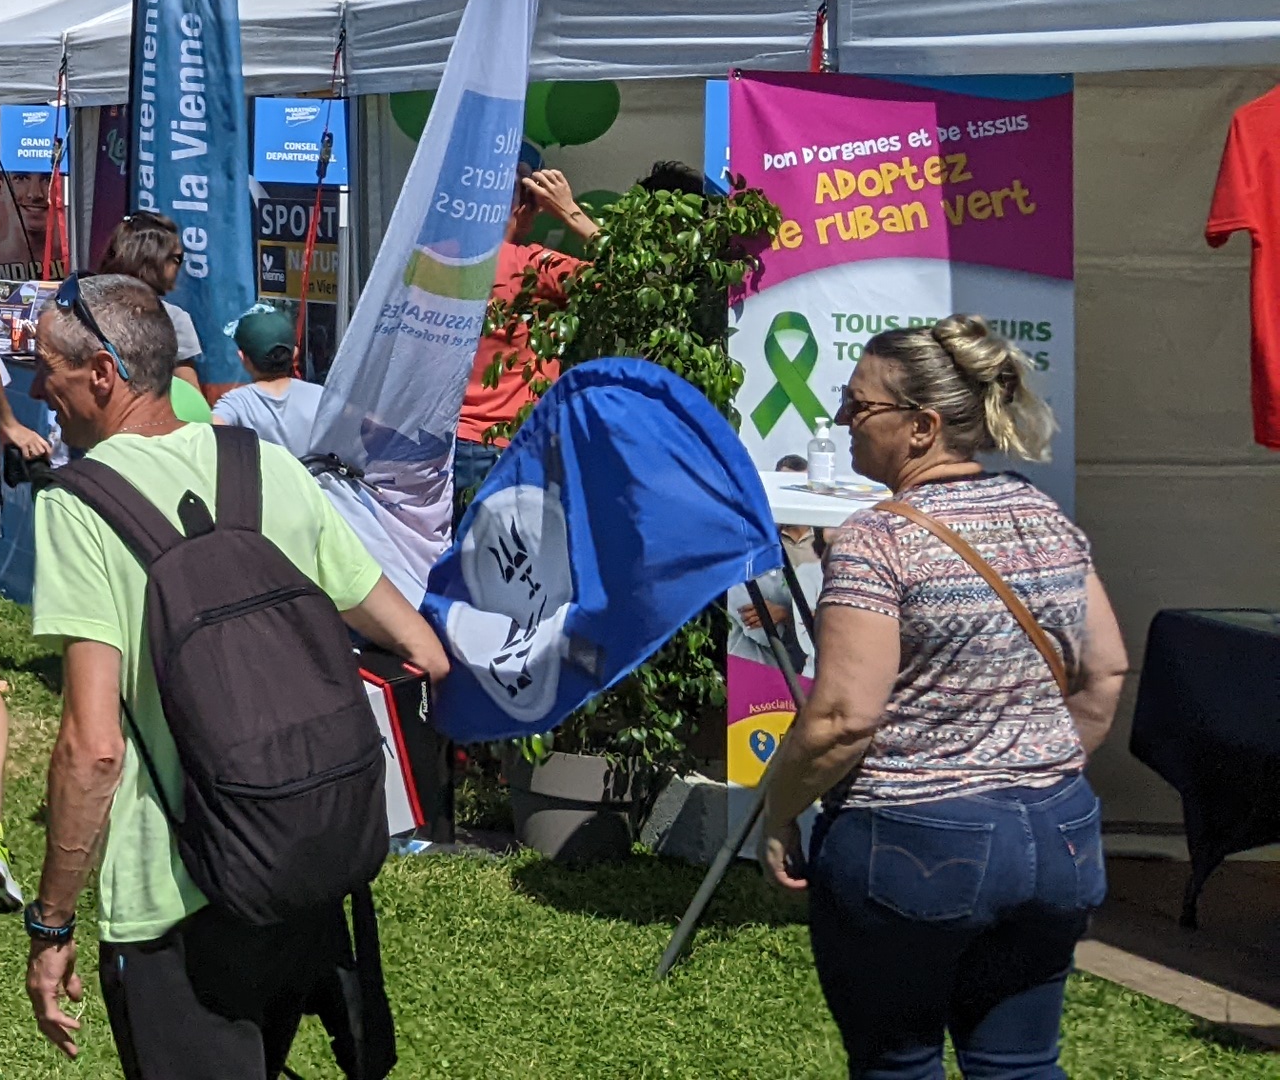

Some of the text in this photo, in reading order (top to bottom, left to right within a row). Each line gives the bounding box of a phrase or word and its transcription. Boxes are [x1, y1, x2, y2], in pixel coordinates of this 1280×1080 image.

[171, 12, 208, 160] Vienne
[908, 128, 932, 148] et
[966, 114, 1030, 139] tissus
[17, 149, 53, 158] POITIERS
[21, 138, 51, 147] GRAND
[284, 142, 318, 151] CONSEIL
[266, 152, 337, 162] DEPARTEMENL
[172, 173, 208, 212] la
[942, 179, 1038, 227] vert
